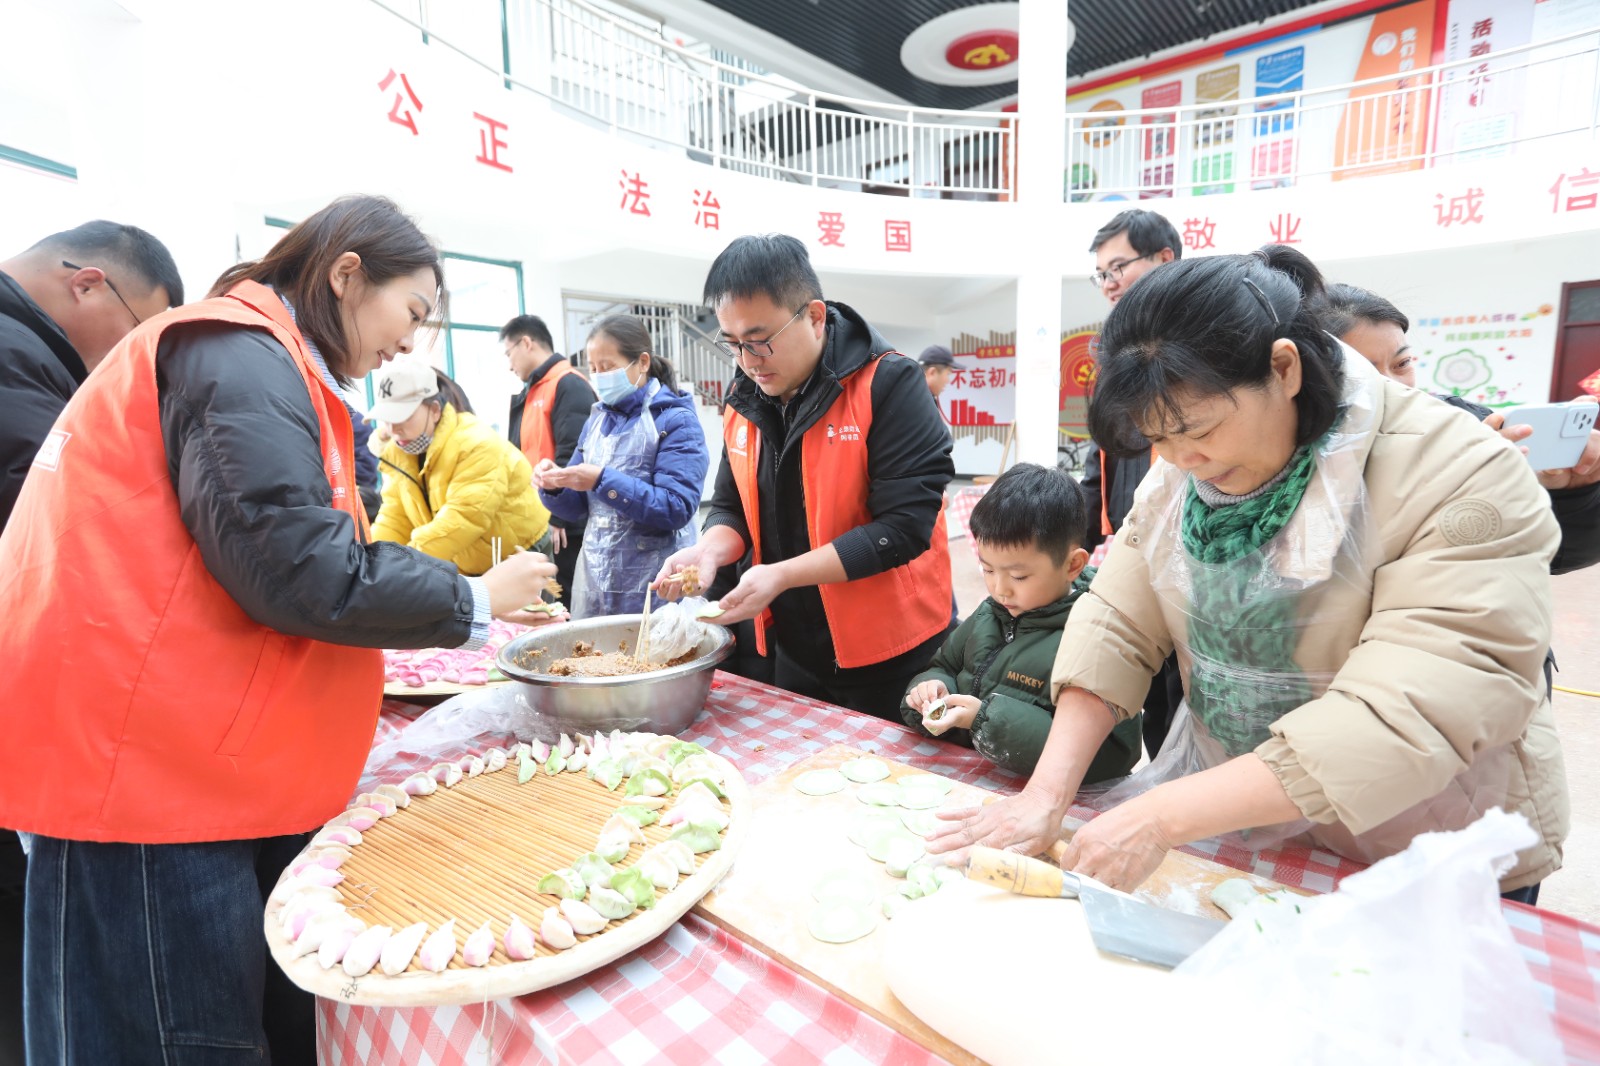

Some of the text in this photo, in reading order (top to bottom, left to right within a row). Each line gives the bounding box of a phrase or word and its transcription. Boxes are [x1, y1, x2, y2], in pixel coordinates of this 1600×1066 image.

[377, 69, 1303, 253] 公正 法治 爱国 敬业
[1434, 167, 1600, 225] 诚信
[1006, 670, 1045, 689] MICKEY
